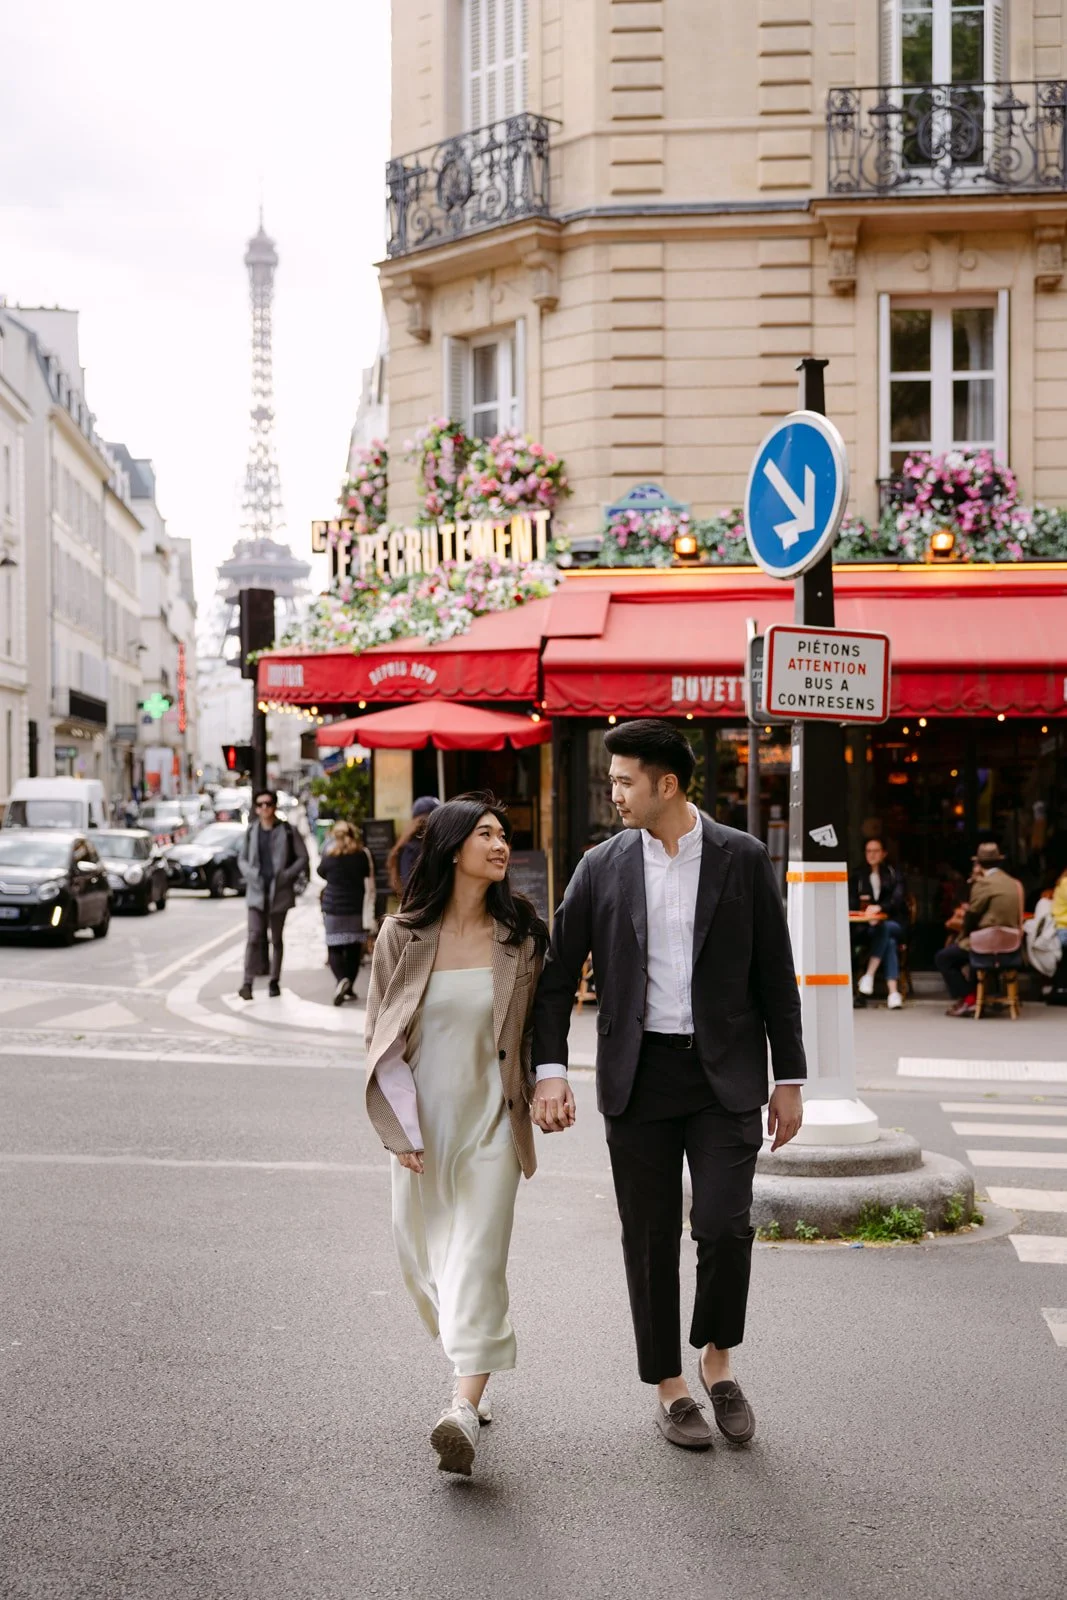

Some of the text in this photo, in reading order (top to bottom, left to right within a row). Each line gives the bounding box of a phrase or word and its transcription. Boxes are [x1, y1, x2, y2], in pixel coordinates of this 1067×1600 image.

[798, 639, 860, 657] PIÉTONS
[788, 658, 867, 676] ATTENTION
[805, 677, 849, 691] BUS A
[778, 693, 875, 711] CONTRESENS
